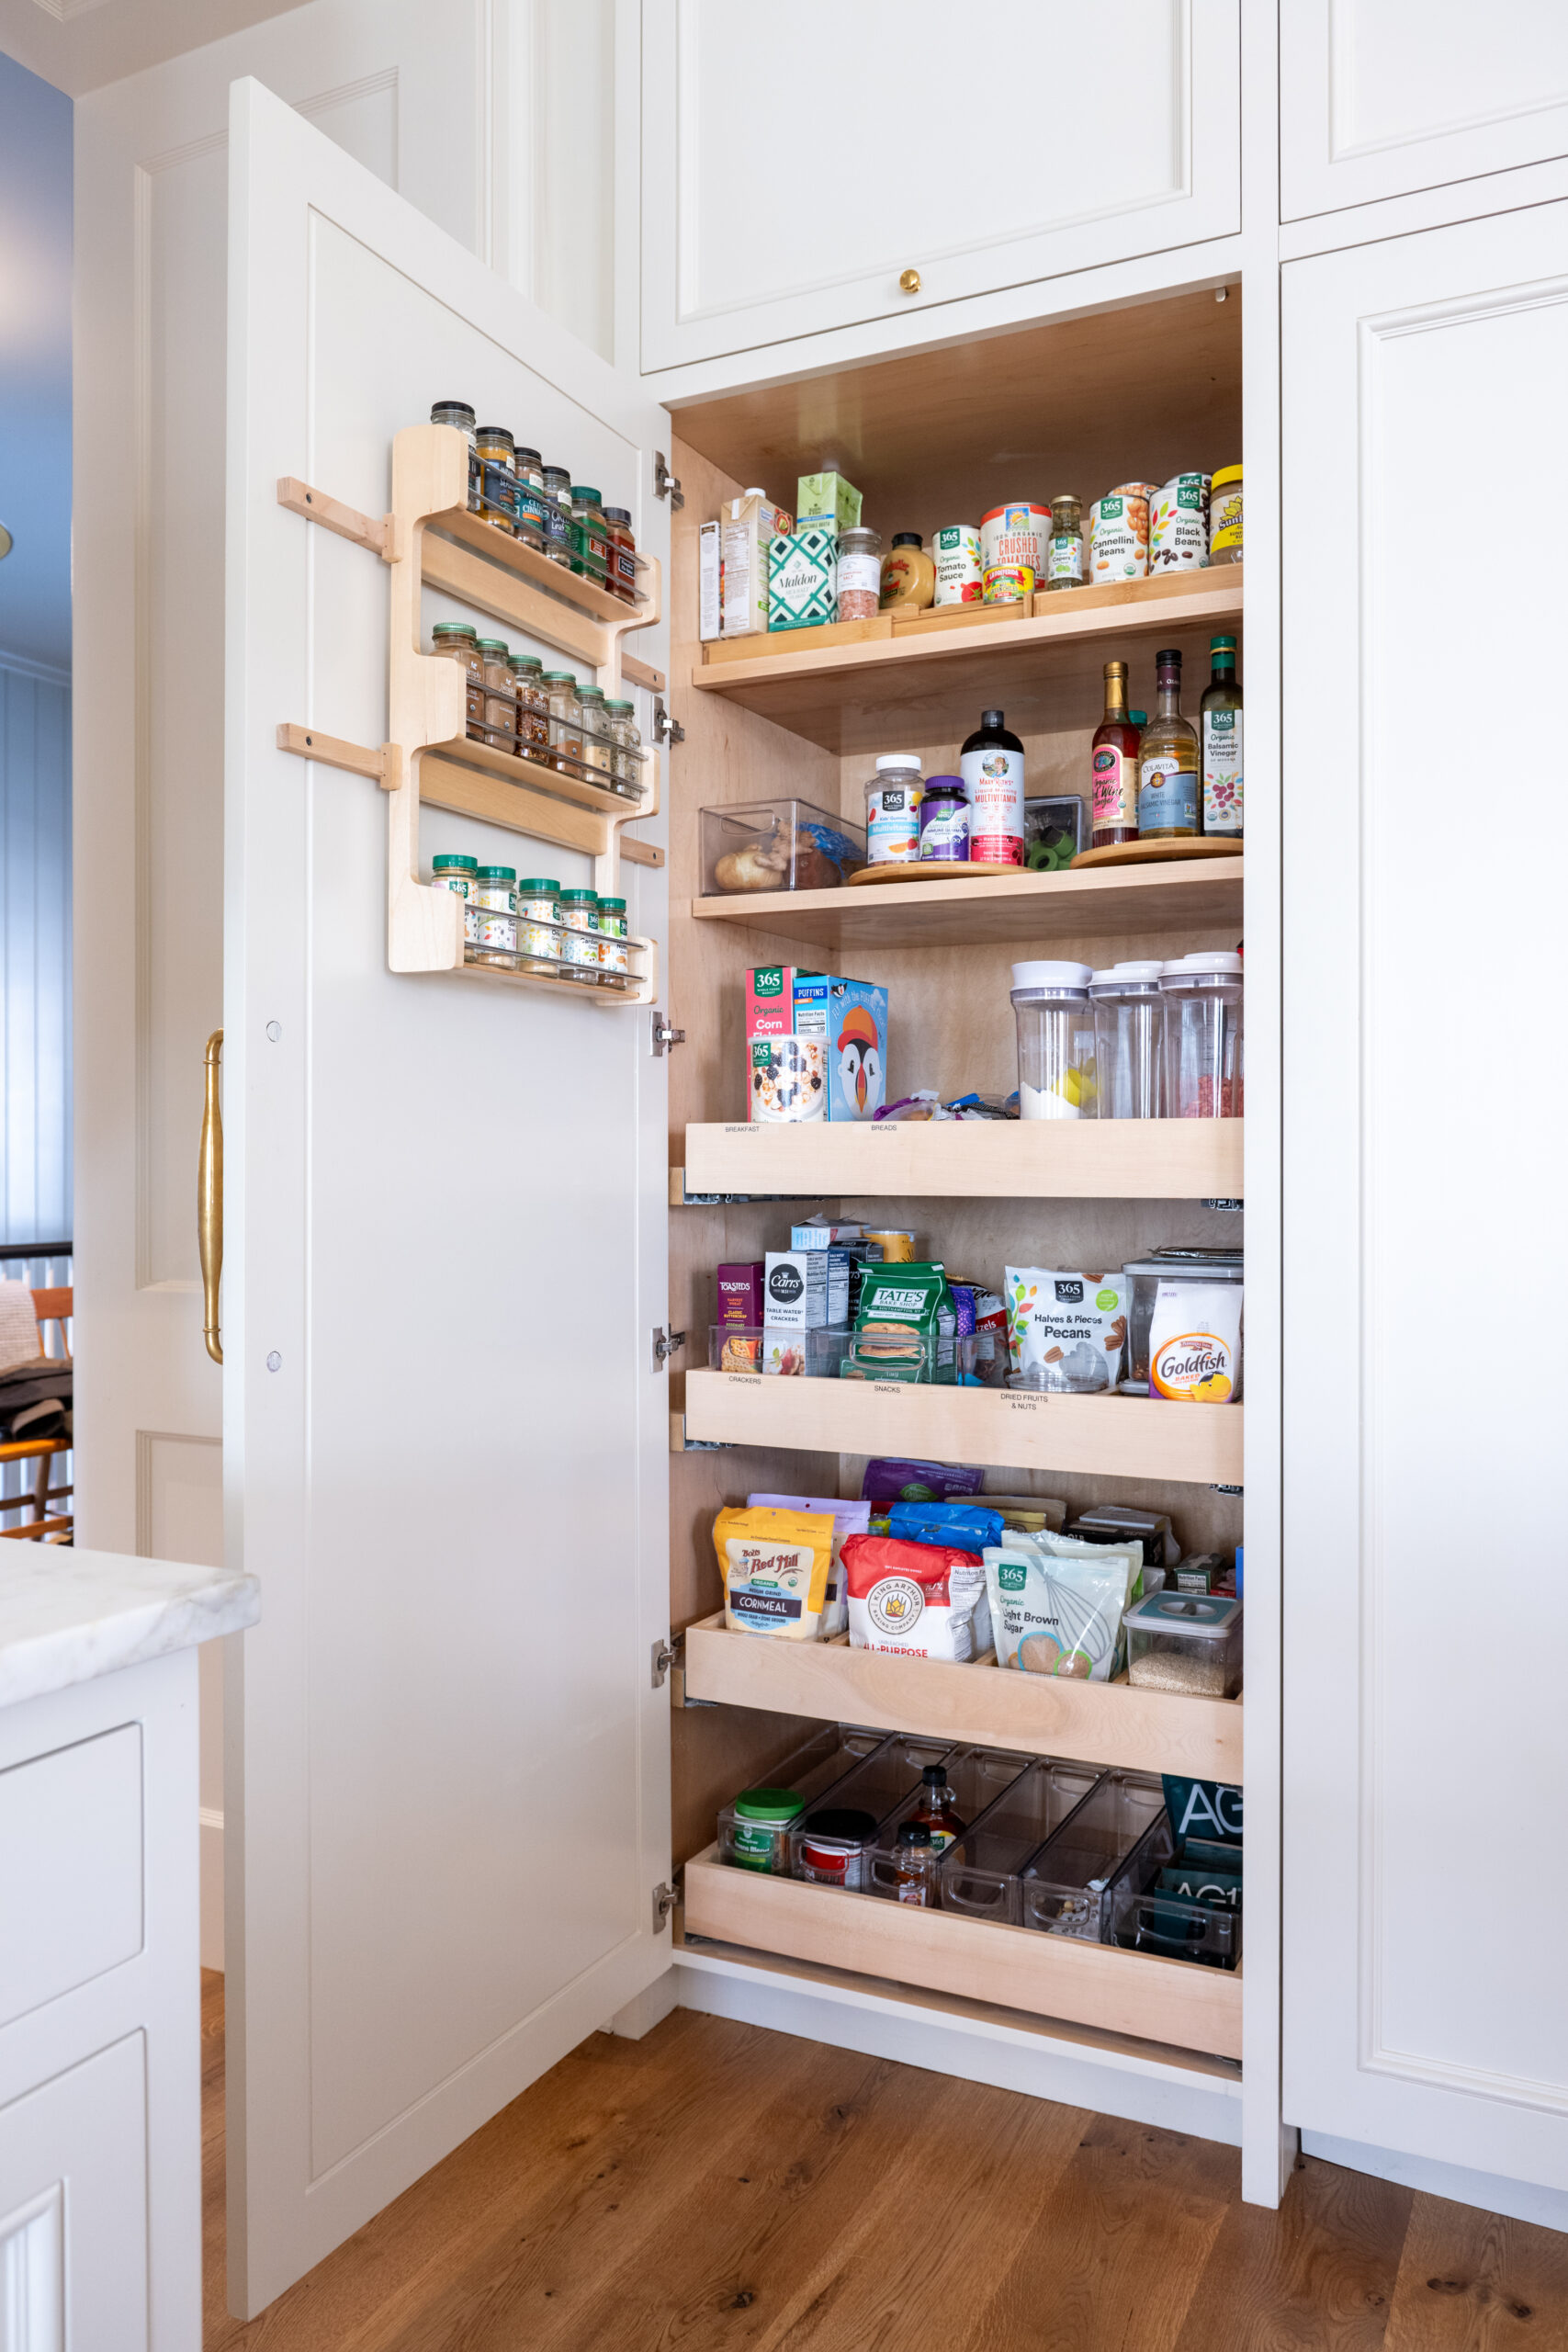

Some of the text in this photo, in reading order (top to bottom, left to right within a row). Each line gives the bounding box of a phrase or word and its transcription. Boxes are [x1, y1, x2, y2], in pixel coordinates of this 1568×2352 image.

[1179, 490, 1198, 501] 365
[1102, 501, 1120, 513] 365
[1176, 516, 1200, 525] Organic
[1100, 527, 1123, 536] Organic
[1176, 527, 1200, 536] Black
[941, 532, 958, 543] 365
[1093, 536, 1134, 550] Cannellini
[1175, 537, 1201, 546] Beans
[999, 537, 1037, 556] CRUSHED
[1099, 548, 1125, 558] Beans
[940, 555, 961, 563] Organic
[937, 563, 966, 573] Tomato
[778, 574, 817, 589] Maldon
[940, 573, 963, 582] Sauce
[1213, 713, 1232, 723] 365
[1143, 763, 1174, 773] COLAVITA
[1101, 786, 1124, 797] Wine
[884, 794, 902, 804] 365
[975, 794, 1016, 803] MULTIVITAMIN
[452, 883, 466, 892] 365
[757, 972, 780, 987] 365
[798, 988, 824, 997] PUFFINS
[754, 1005, 784, 1017] Organic
[756, 1019, 782, 1029] Corn
[754, 1045, 768, 1057] 365
[720, 1282, 750, 1292] TOASTEDS
[1058, 1283, 1080, 1295] 365
[879, 1289, 925, 1302] TATE'S
[1035, 1314, 1064, 1323] Halves
[1075, 1315, 1102, 1324] Pieces
[976, 1320, 997, 1332] tzels
[1044, 1326, 1091, 1338] Pecans
[1161, 1351, 1225, 1378] Goldfish
[729, 1376, 761, 1385] CRACKERS
[1001, 1393, 1048, 1402] DRIED FRUITS
[749, 1554, 799, 1576] Red Mill
[1001, 1568, 1023, 1582] 365
[874, 1583, 920, 1606] KING ARTHUR
[739, 1597, 787, 1613] CORNMEAL
[1000, 1595, 1024, 1606] Organic
[873, 1609, 915, 1630] BAKING COMPANY
[1024, 1612, 1059, 1625] Brown
[1004, 1620, 1024, 1634] Sugar
[1179, 1783, 1243, 1835] AG
